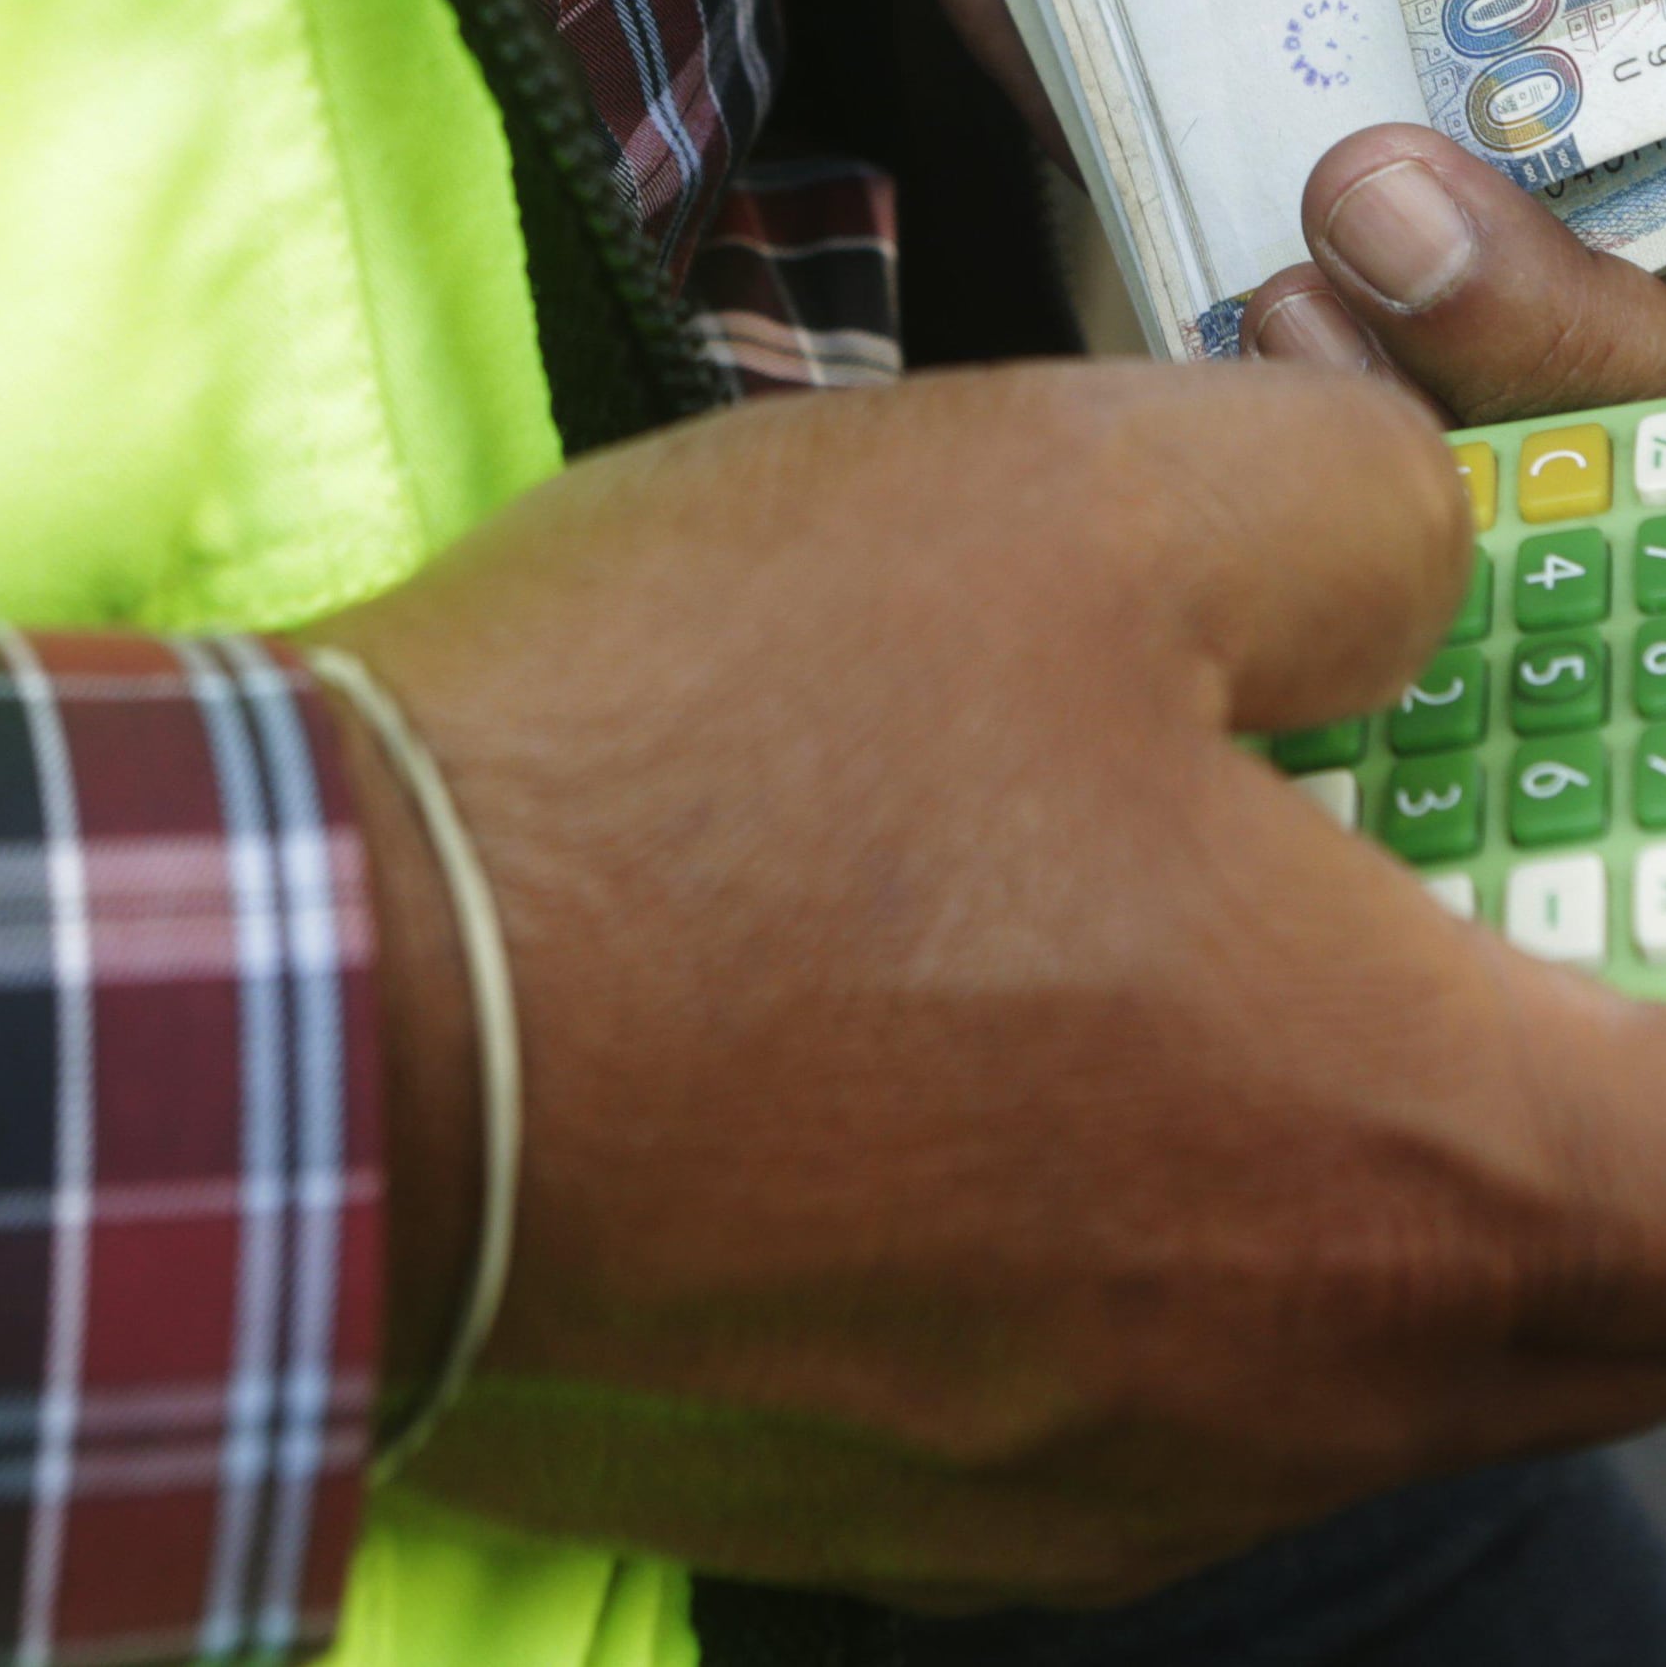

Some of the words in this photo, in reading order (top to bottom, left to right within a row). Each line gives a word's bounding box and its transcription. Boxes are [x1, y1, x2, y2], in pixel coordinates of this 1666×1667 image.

[1530, 449, 1587, 476] C
[1525, 554, 1586, 590] 4
[1521, 655, 1585, 686] 5
[1521, 762, 1589, 798] 6
[1396, 784, 1461, 817] 3
